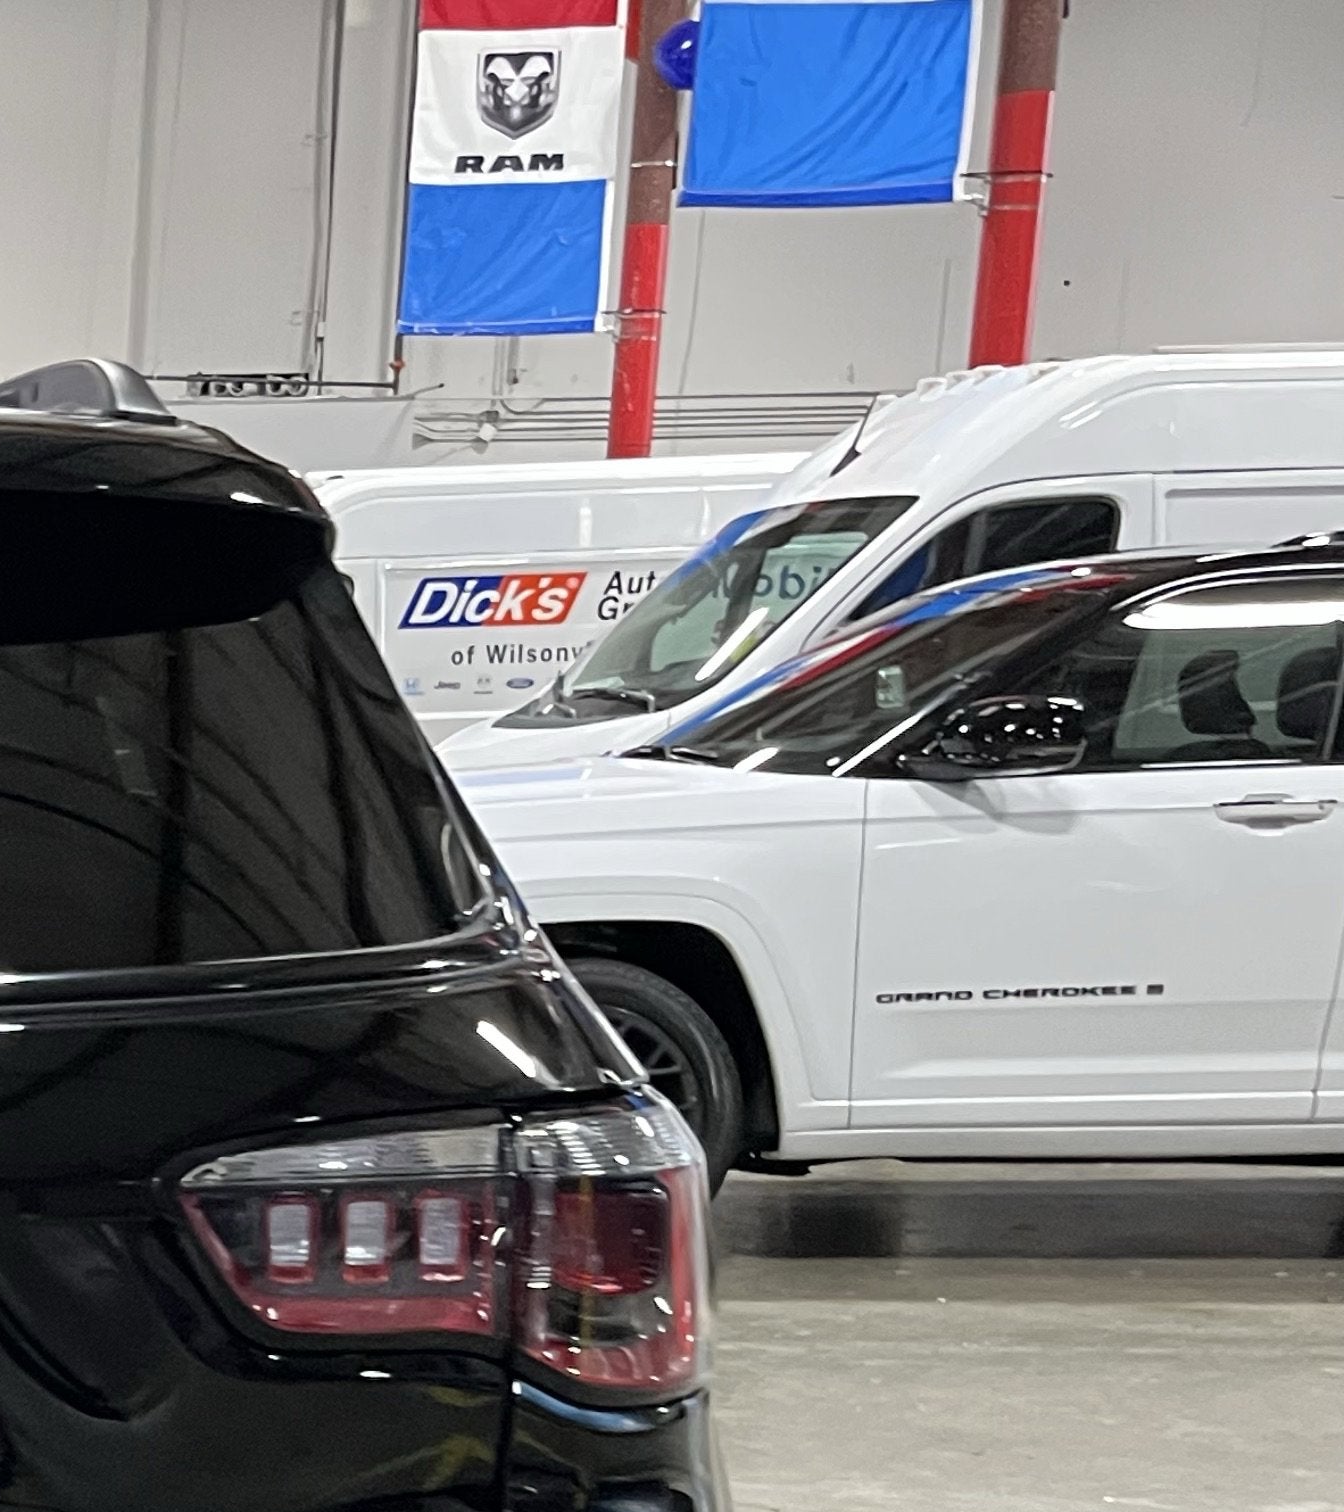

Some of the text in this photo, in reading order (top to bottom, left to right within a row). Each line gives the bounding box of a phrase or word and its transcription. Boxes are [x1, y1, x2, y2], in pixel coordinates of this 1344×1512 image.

[455, 153, 564, 174] RAM
[603, 570, 657, 595] Aut
[408, 576, 568, 625] Dick's
[451, 645, 475, 665] of
[875, 985, 1137, 1005] GRAND CHEROKEE
